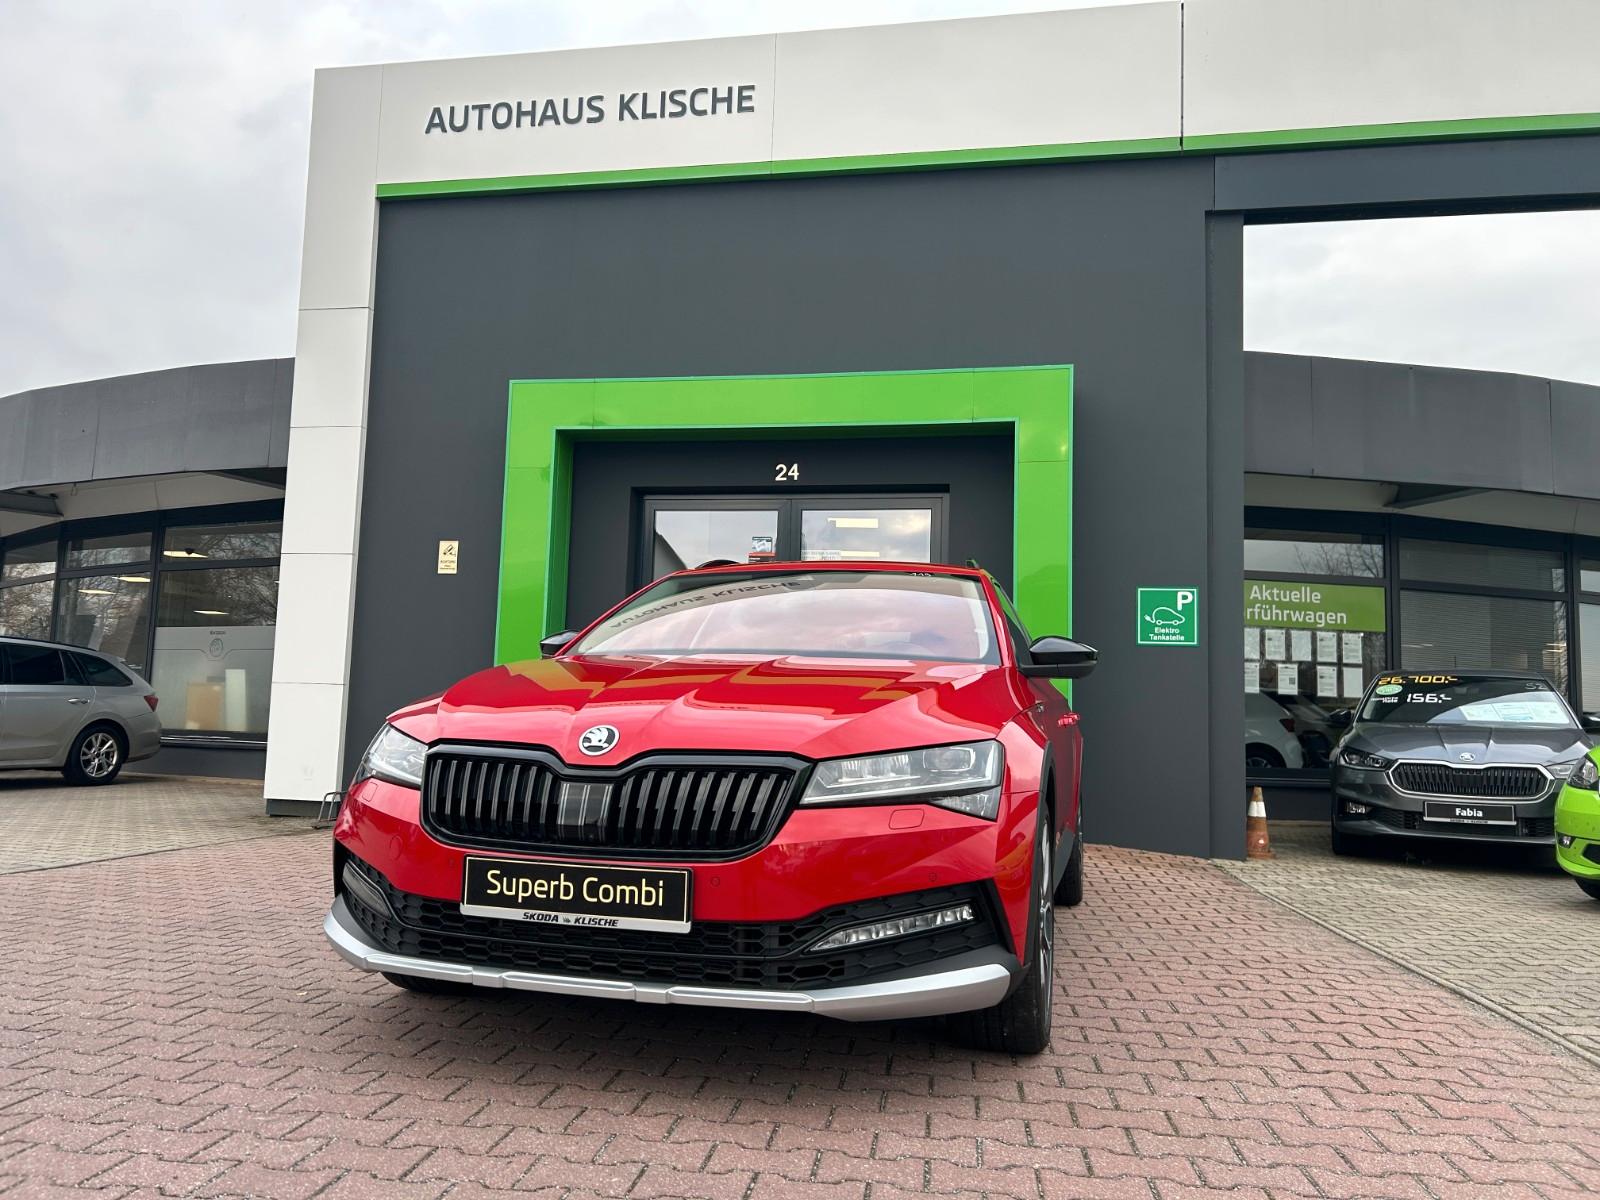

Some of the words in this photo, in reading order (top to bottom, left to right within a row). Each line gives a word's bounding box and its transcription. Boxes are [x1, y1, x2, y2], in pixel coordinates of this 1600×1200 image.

[425, 95, 605, 134] AUTOHAUS
[618, 85, 756, 122] KLISCHE
[775, 463, 800, 481] 24
[1176, 591, 1194, 611] P
[1250, 585, 1321, 604] Aktuelle
[1246, 604, 1347, 627] rführwagen
[1455, 807, 1483, 817] Fabia
[487, 870, 574, 903] Superb
[583, 877, 664, 906] Combi
[574, 917, 619, 927] KLISCHE
